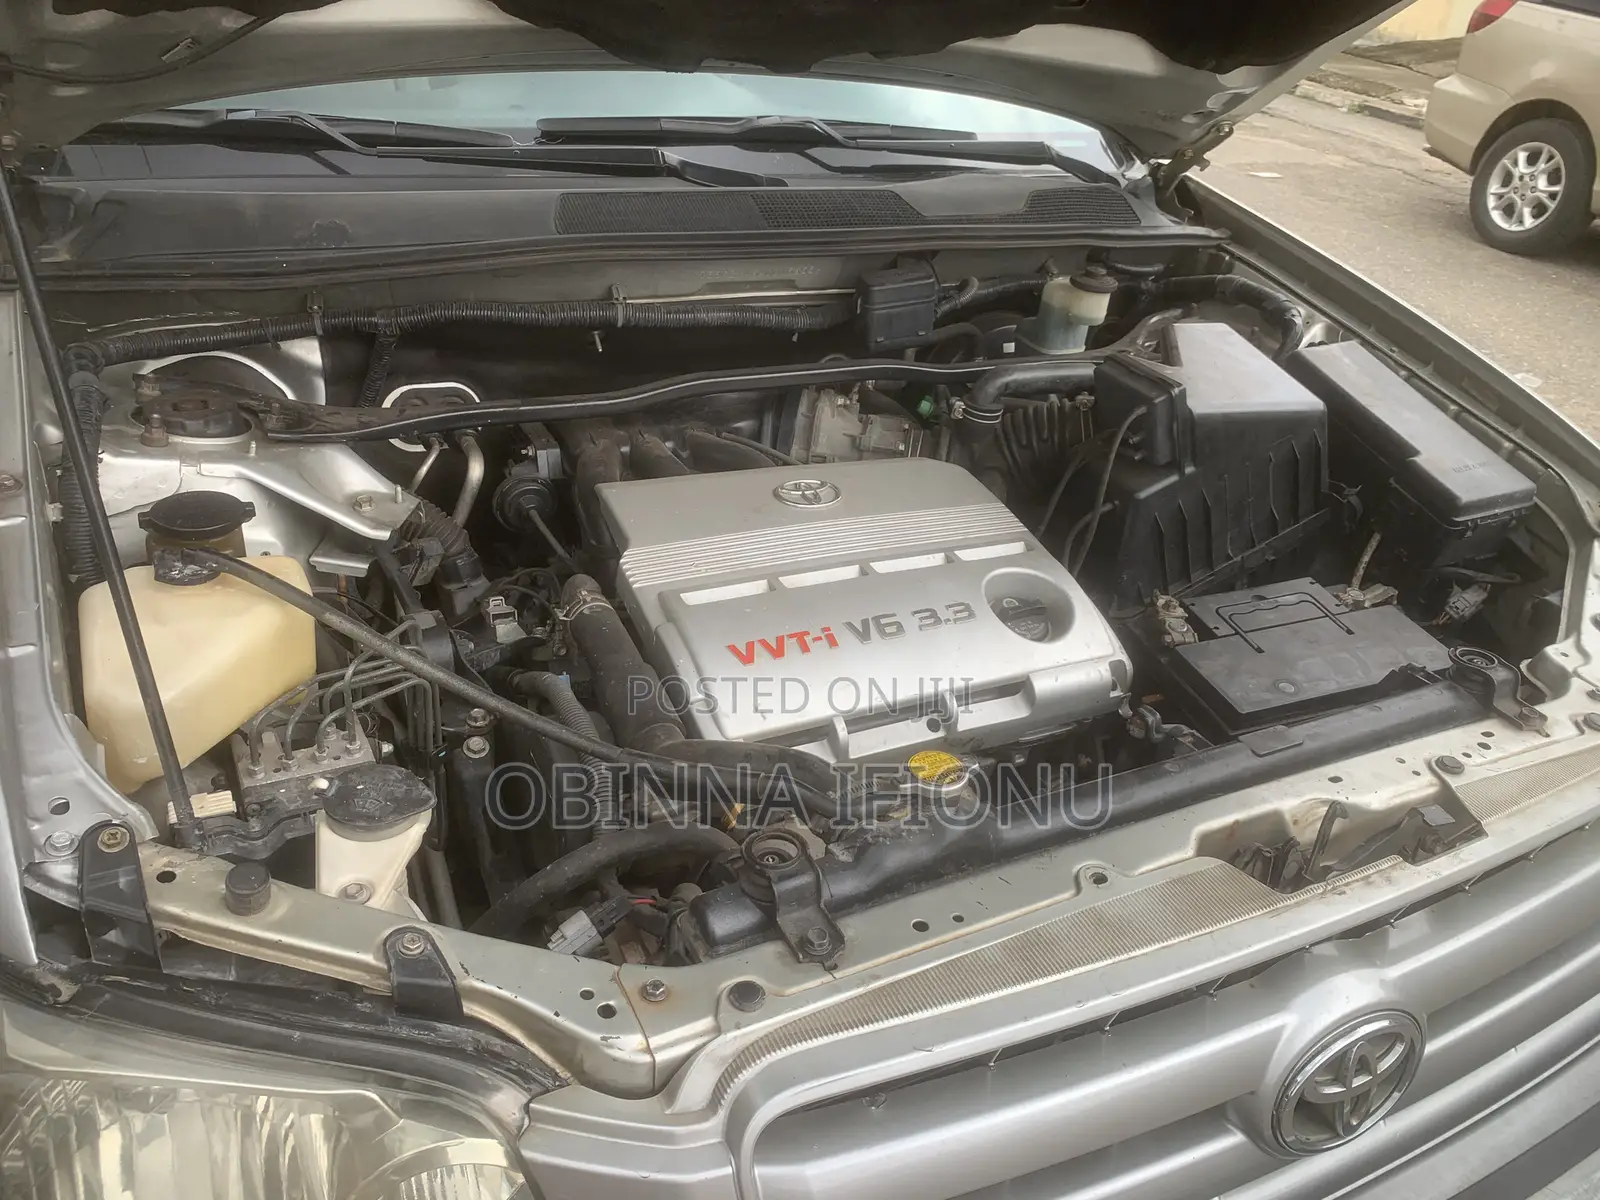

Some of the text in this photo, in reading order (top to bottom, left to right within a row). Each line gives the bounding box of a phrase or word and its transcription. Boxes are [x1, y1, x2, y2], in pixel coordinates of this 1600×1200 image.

[725, 601, 976, 667] VVT-i V6 3.3
